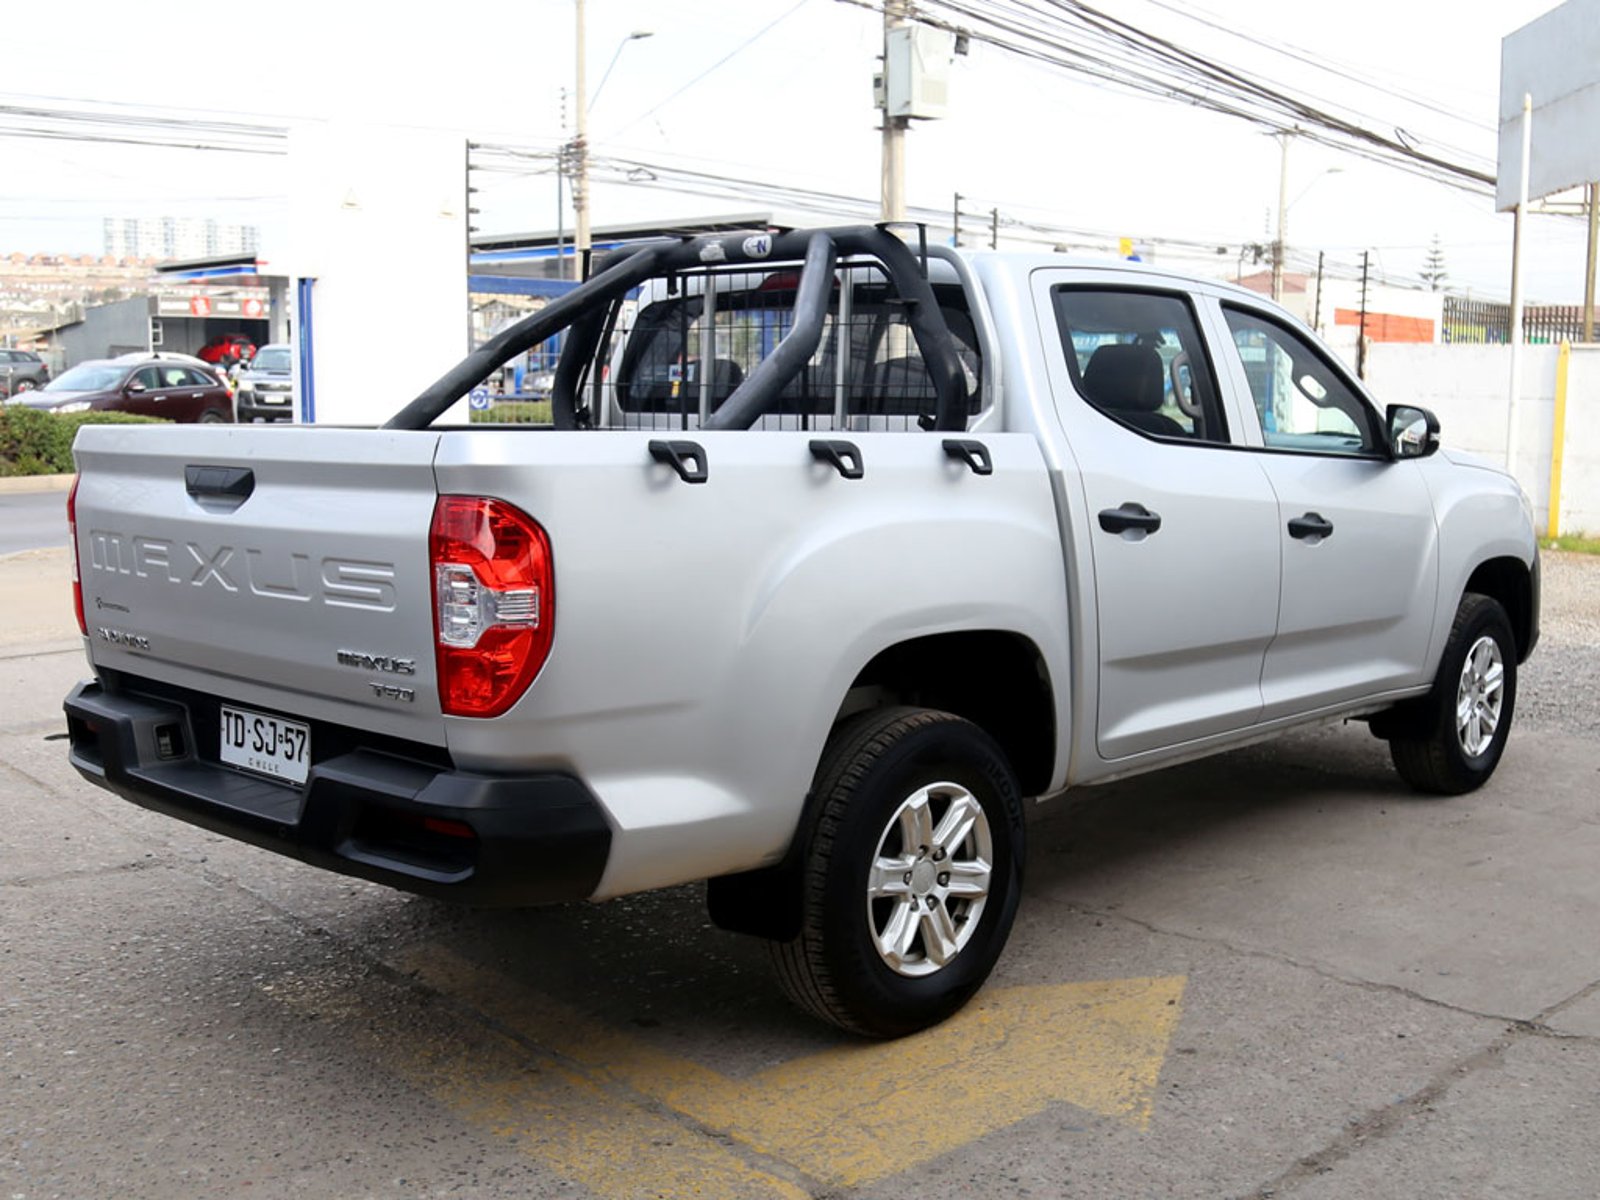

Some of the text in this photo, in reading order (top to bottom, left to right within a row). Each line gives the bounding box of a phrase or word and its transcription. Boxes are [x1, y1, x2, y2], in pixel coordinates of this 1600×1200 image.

[90, 529, 398, 613] MAXUS
[337, 649, 416, 675] MAXUS
[247, 757, 281, 774] CHILE
